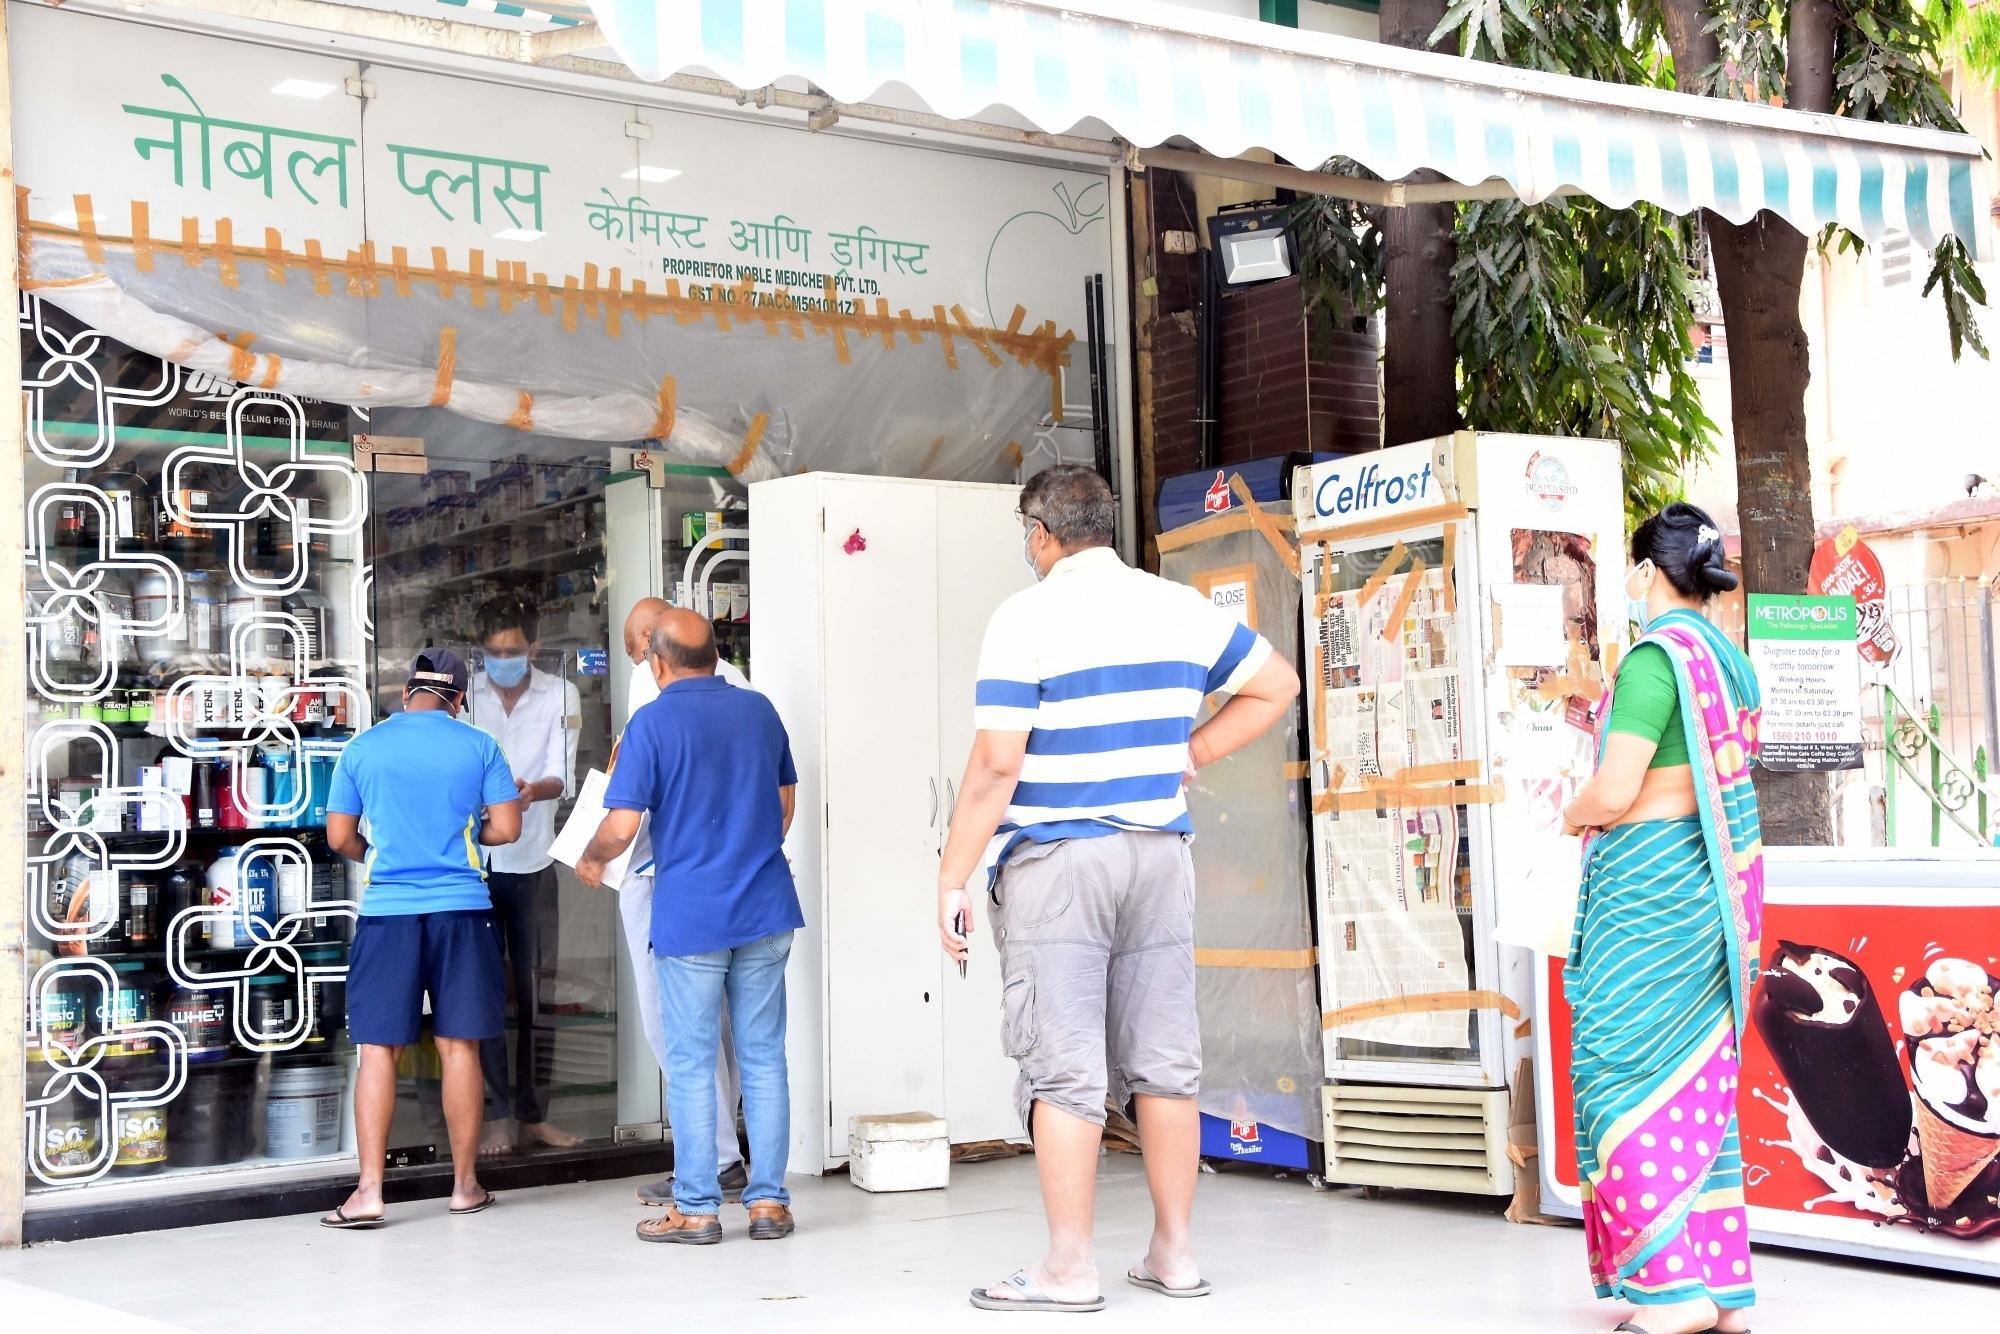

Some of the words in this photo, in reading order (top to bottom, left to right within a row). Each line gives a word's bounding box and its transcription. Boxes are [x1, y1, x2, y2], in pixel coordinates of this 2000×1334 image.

[121, 73, 358, 209] नोबल
[386, 143, 551, 233] प्लस
[584, 187, 709, 249] केमिस्ट
[728, 214, 812, 264] आणि
[662, 257, 733, 280] PROPRIETOR
[736, 265, 772, 284] NOBLE
[775, 269, 832, 290] MEDICHEM
[834, 275, 856, 293] PVT.
[858, 278, 881, 296] LTD.
[688, 286, 712, 302] GST
[168, 407, 208, 419] WORLD'S
[209, 411, 232, 421] BES
[237, 413, 271, 424] ELLING
[273, 414, 310, 427] PROEN
[312, 420, 339, 430] BRAND
[1316, 463, 1431, 517] Celfrost
[1214, 588, 1245, 607] CLOSE
[1755, 605, 1847, 622] METROPOLIS
[1763, 645, 1796, 657] Diagnose
[1799, 647, 1819, 657] today
[1821, 647, 1832, 658] for
[1770, 662, 1795, 671] healthy
[1779, 676, 1804, 684] Working
[1771, 687, 1794, 695] Monday
[1803, 687, 1833, 695] Saturday
[1772, 732, 1792, 742] 1860
[1795, 732, 1812, 742] 210
[1815, 732, 1837, 742] 1010
[171, 1008, 225, 1025] WHEY
